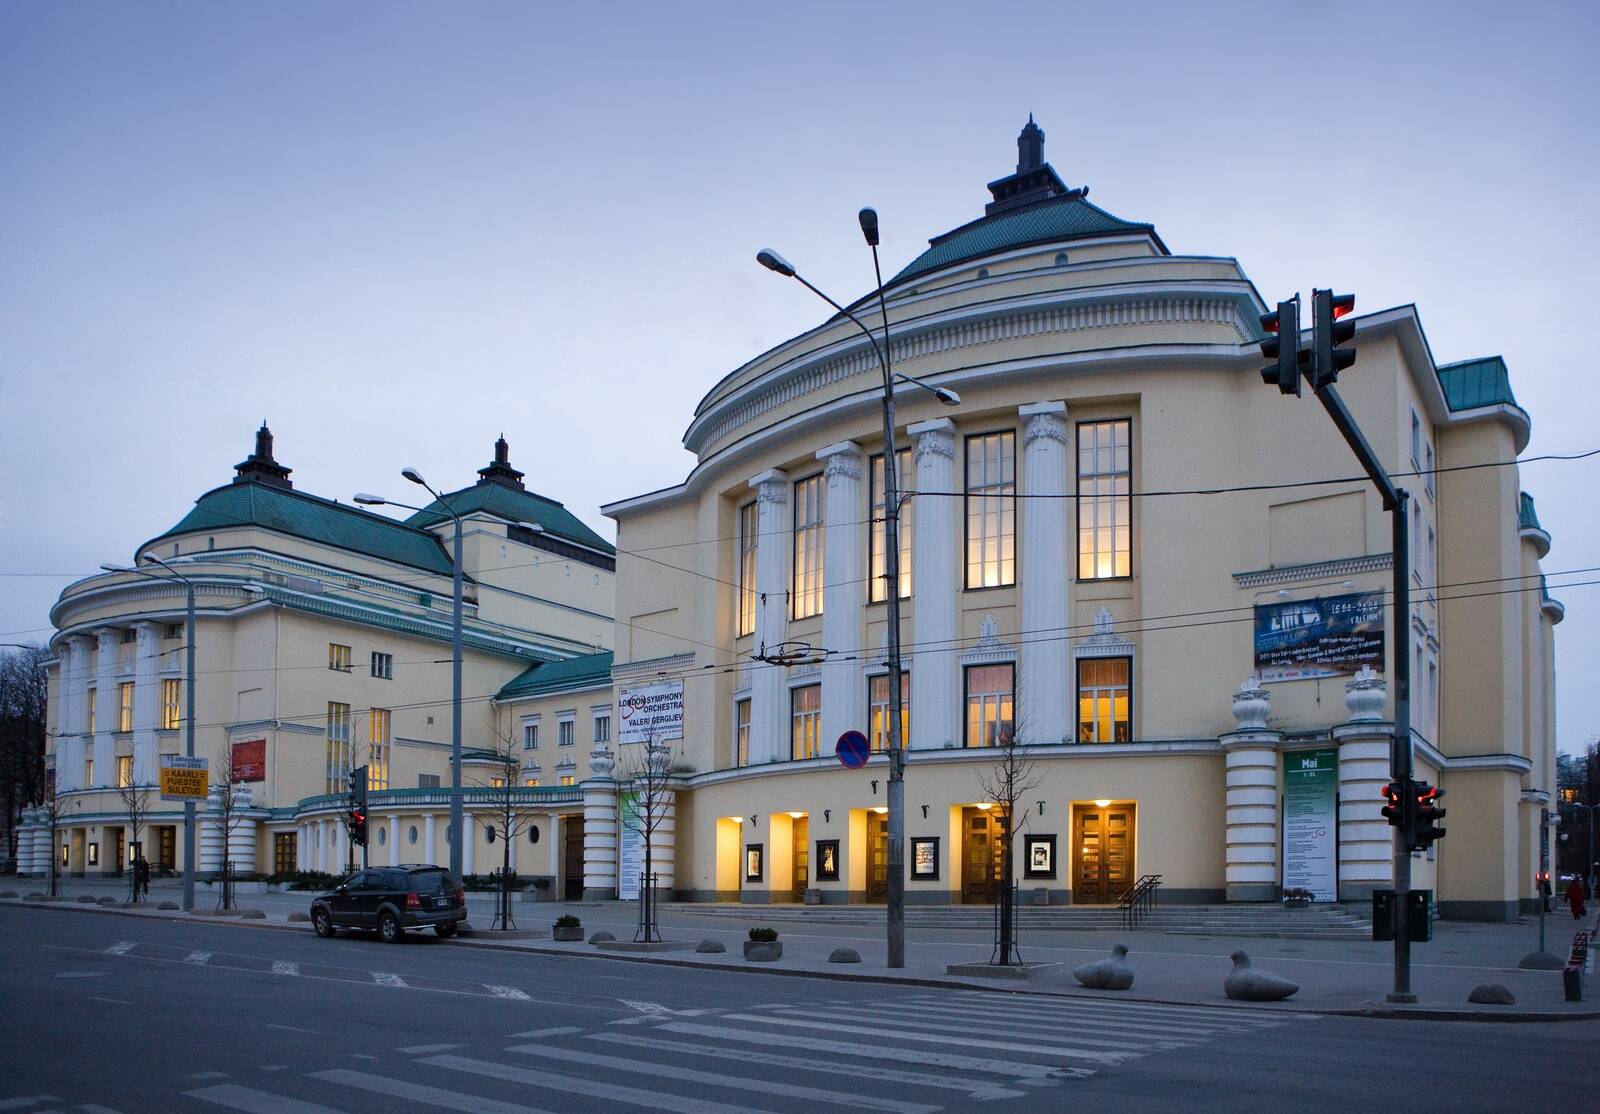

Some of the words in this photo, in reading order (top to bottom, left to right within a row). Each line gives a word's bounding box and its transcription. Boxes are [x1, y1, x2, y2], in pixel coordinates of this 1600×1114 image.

[619, 696, 646, 707] LONDON
[647, 692, 683, 703] SYMPHONY
[644, 702, 683, 713] ORCHESTRA
[629, 717, 650, 726] VALERI
[652, 714, 682, 724] GERGIJEV
[1302, 758, 1318, 768] Mai
[167, 778, 202, 787] PUIESTEE
[167, 786, 201, 795] SULETUD
